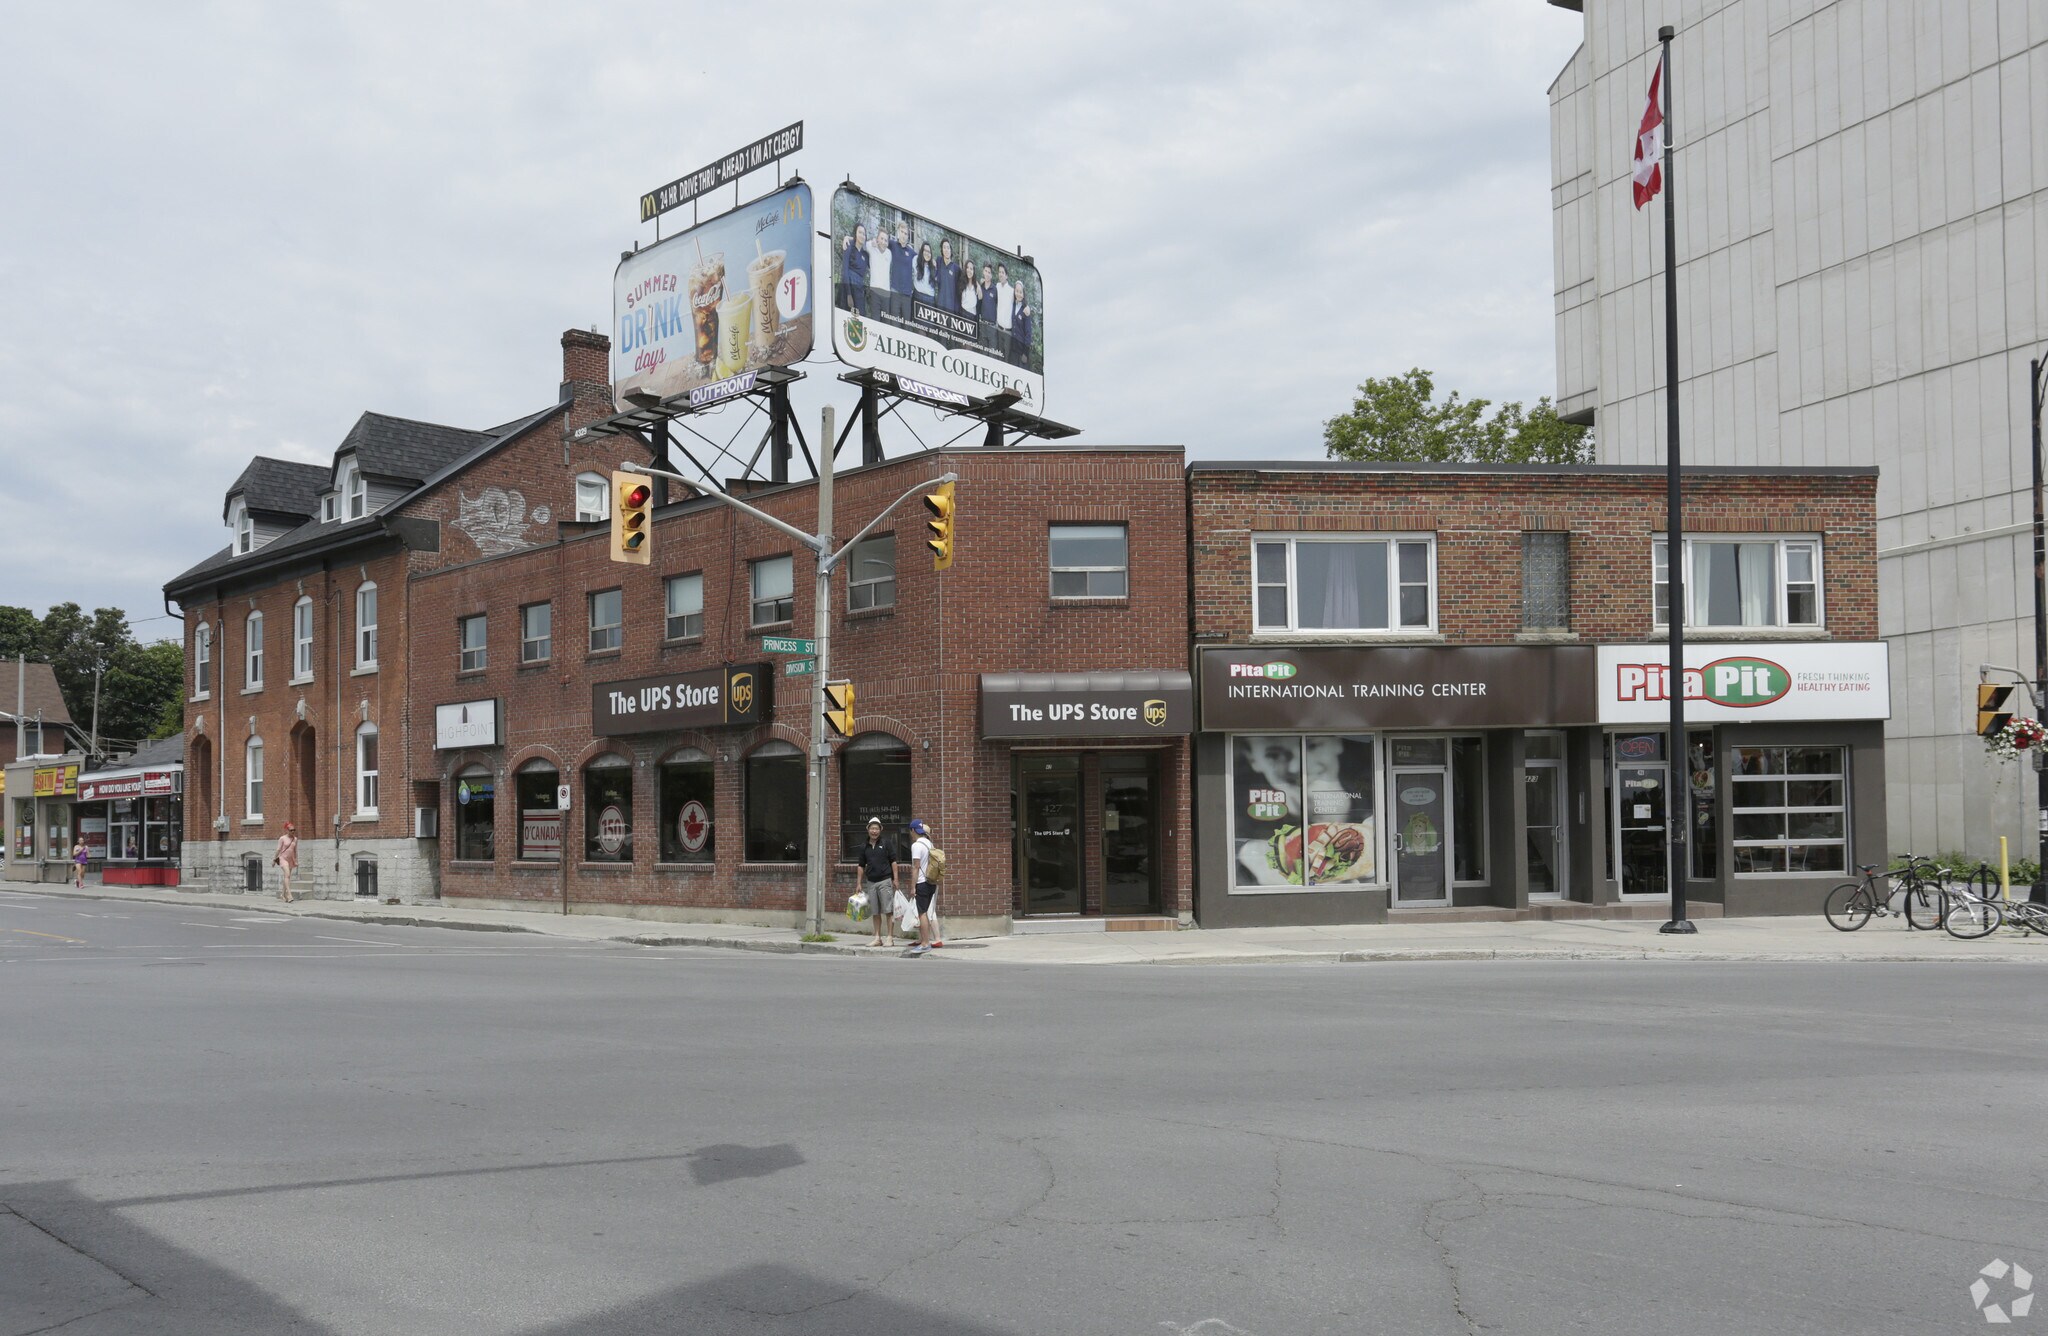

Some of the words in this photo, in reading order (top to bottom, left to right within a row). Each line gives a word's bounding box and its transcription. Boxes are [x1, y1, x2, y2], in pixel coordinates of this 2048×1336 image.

[660, 190, 668, 210] 24
[668, 188, 678, 206] HR
[680, 176, 698, 201] DRIVE
[699, 166, 715, 192] THRU
[722, 155, 744, 181] AHEAD
[746, 149, 750, 169] 1
[750, 145, 762, 166] KM
[763, 138, 773, 161] AT
[774, 126, 800, 156] CLERGY
[626, 274, 677, 309] SUMMER
[784, 277, 796, 311] $1
[621, 293, 683, 354] DRINK
[917, 306, 951, 327] APPLY
[950, 316, 976, 335] NOW
[881, 310, 904, 324] Financial
[905, 319, 928, 332] assistance
[928, 325, 938, 335] and
[938, 328, 950, 340] daily
[950, 334, 982, 352] transportation
[874, 334, 938, 368] ALBERT
[634, 347, 666, 375] days
[872, 370, 890, 382] 4330
[692, 374, 753, 404] OUTFRONT
[900, 378, 964, 405] OUTFRONT
[764, 640, 797, 651] PRINCESS
[806, 642, 814, 652] ST
[786, 662, 805, 674] DIVISION
[1230, 664, 1263, 677] Pita
[1268, 664, 1292, 677] Pit
[1798, 672, 1826, 681] FRESH
[1828, 672, 1870, 681] THINKING
[1228, 685, 1344, 698] INTERNATIONAL
[1352, 684, 1424, 697] TRAINING
[1432, 683, 1486, 696] CENTER
[1618, 665, 1704, 700] Pia
[1714, 666, 1772, 696] Pit
[1798, 683, 1836, 692] HEALTHY
[1839, 683, 1870, 692] EATING
[609, 692, 636, 715] The
[640, 686, 671, 712] UPS
[676, 684, 719, 708] Store
[733, 684, 751, 708] ups
[1010, 704, 1043, 721] The
[1049, 704, 1085, 721] UPS
[1090, 703, 1137, 721] Store
[1146, 707, 1165, 722] ups
[438, 722, 493, 740] HIGHPOINT
[1622, 740, 1654, 753] OPEN
[99, 784, 108, 793] HOW
[109, 784, 114, 793] DO
[114, 784, 123, 792] YOU
[123, 783, 131, 791] LIKE
[1249, 790, 1285, 803] Pita
[1042, 805, 1062, 813] 427
[1255, 804, 1280, 817] Pit
[524, 826, 560, 841] O'CANADA
[602, 819, 622, 841] 150
